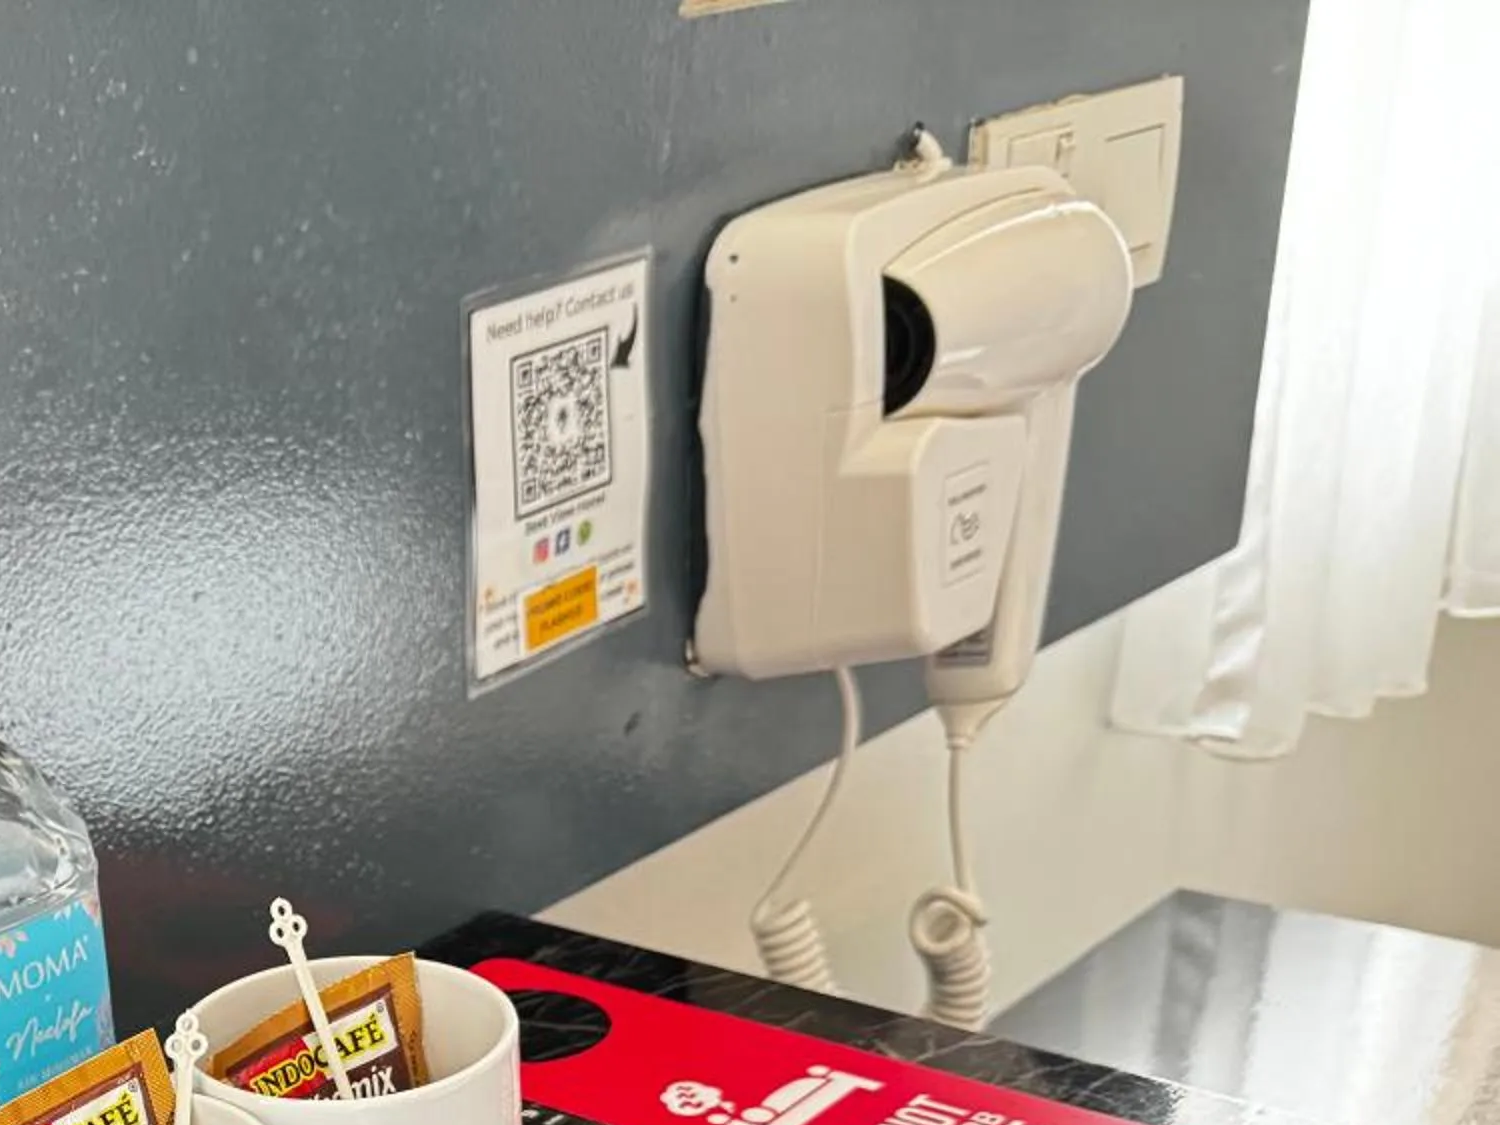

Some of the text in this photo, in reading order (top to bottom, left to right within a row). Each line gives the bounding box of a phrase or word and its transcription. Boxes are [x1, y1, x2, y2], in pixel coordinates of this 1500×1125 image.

[486, 313, 522, 342] Need
[525, 302, 562, 328] help?
[565, 287, 615, 317] Contact
